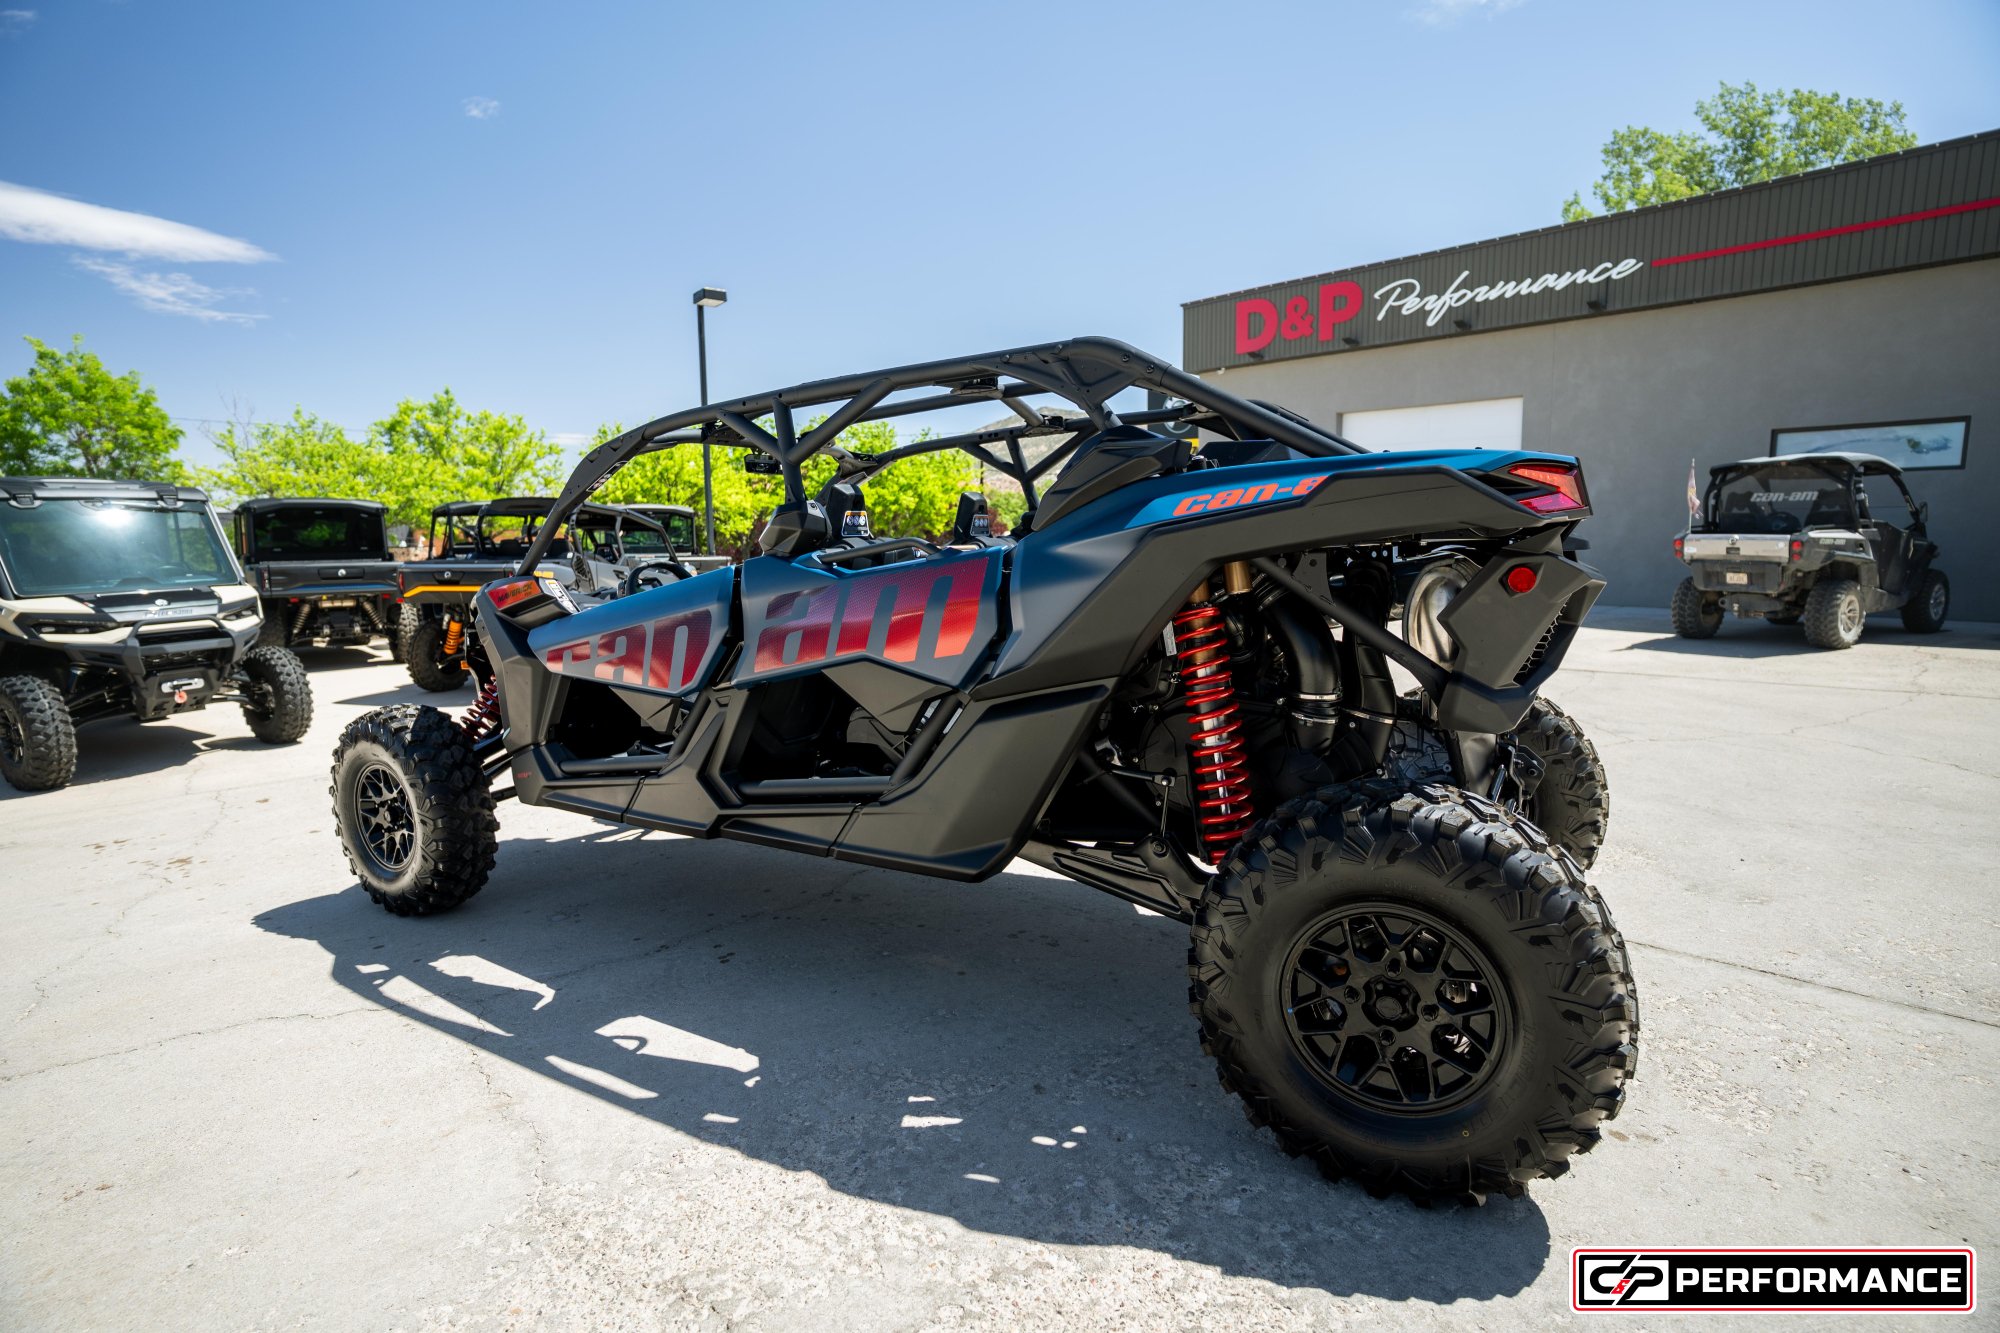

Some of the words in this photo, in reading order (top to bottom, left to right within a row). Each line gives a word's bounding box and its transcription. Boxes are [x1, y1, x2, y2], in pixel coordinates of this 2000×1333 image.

[1235, 280, 1363, 354] D&P
[1374, 258, 1643, 326] Performance
[1750, 491, 1818, 502] can-am
